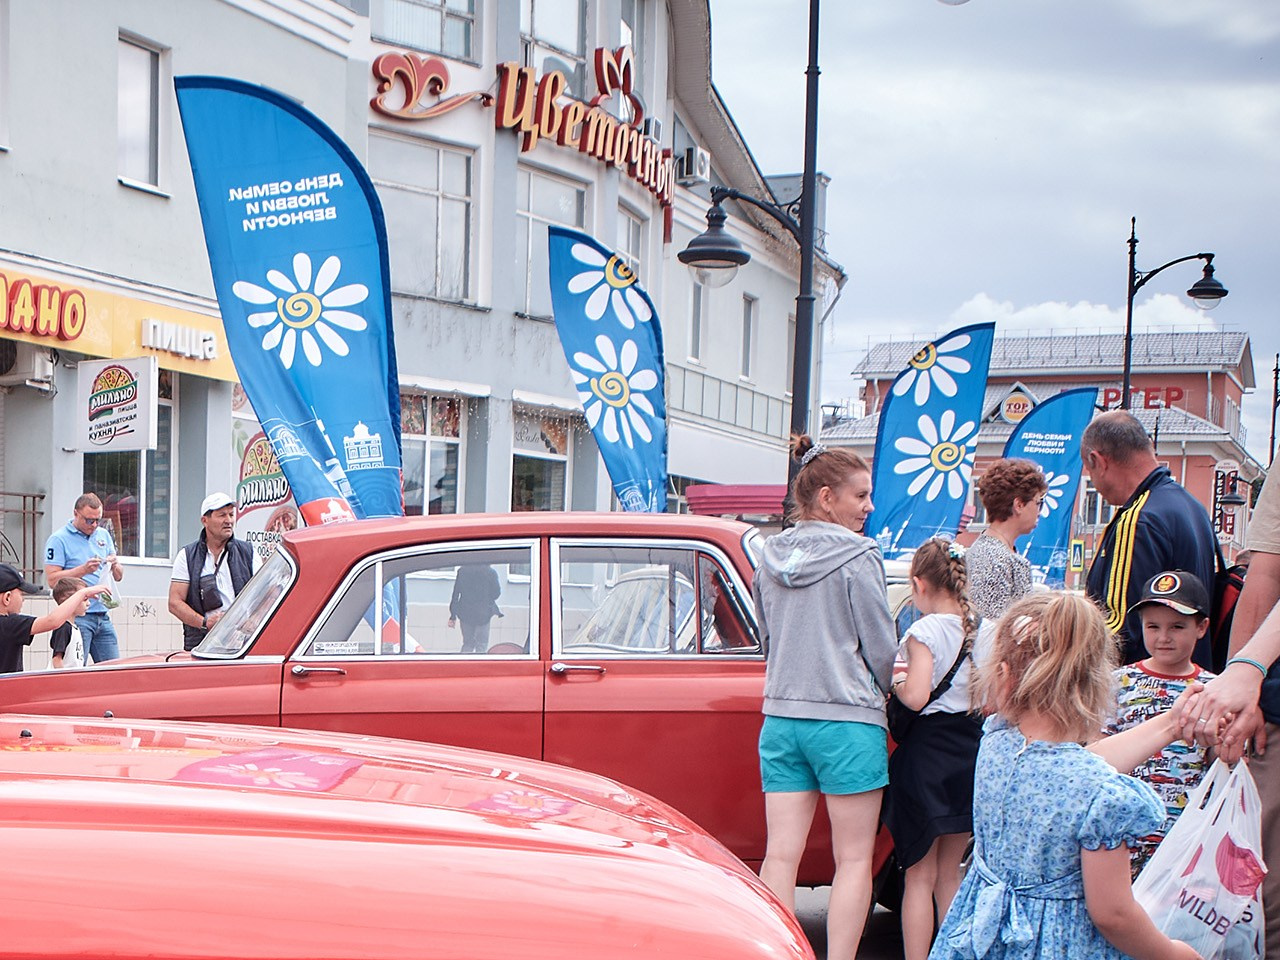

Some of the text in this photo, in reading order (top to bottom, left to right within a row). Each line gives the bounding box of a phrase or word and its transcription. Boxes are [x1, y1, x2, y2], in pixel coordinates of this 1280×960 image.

[141, 319, 217, 360] пицца
[90, 385, 136, 411] МИЛАНО
[1006, 402, 1029, 410] TOP
[1021, 432, 1043, 440] ДЕНЬ
[1027, 439, 1057, 448] ЛЮБВИ
[1023, 446, 1066, 455] ВЕРНОСТИ
[239, 477, 289, 511] МИЛАНО
[1214, 472, 1225, 533] РЕСТОРАН
[246, 530, 281, 543] ДОСТАВКА
[47, 548, 54, 560] 3
